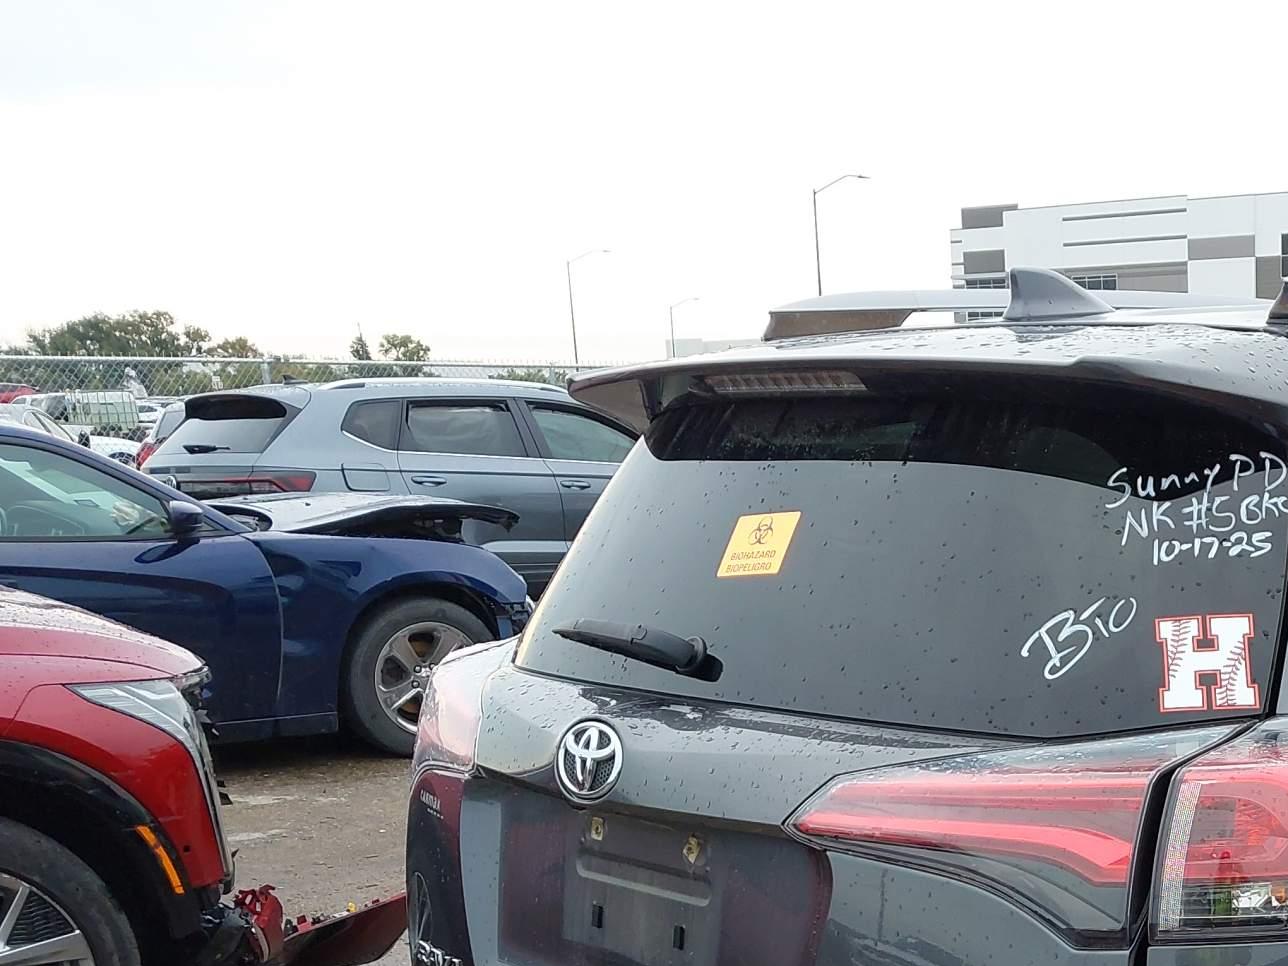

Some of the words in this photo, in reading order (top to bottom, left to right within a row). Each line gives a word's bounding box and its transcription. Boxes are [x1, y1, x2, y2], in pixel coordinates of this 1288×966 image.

[1105, 464, 1221, 509] Sunny
[1229, 451, 1287, 492] PD
[1182, 492, 1236, 534] #5
[725, 562, 772, 573] BIOPELIGRO
[731, 550, 777, 561] BIOHAZARD
[1153, 531, 1273, 566] 10-17-25
[1155, 613, 1261, 713] H
